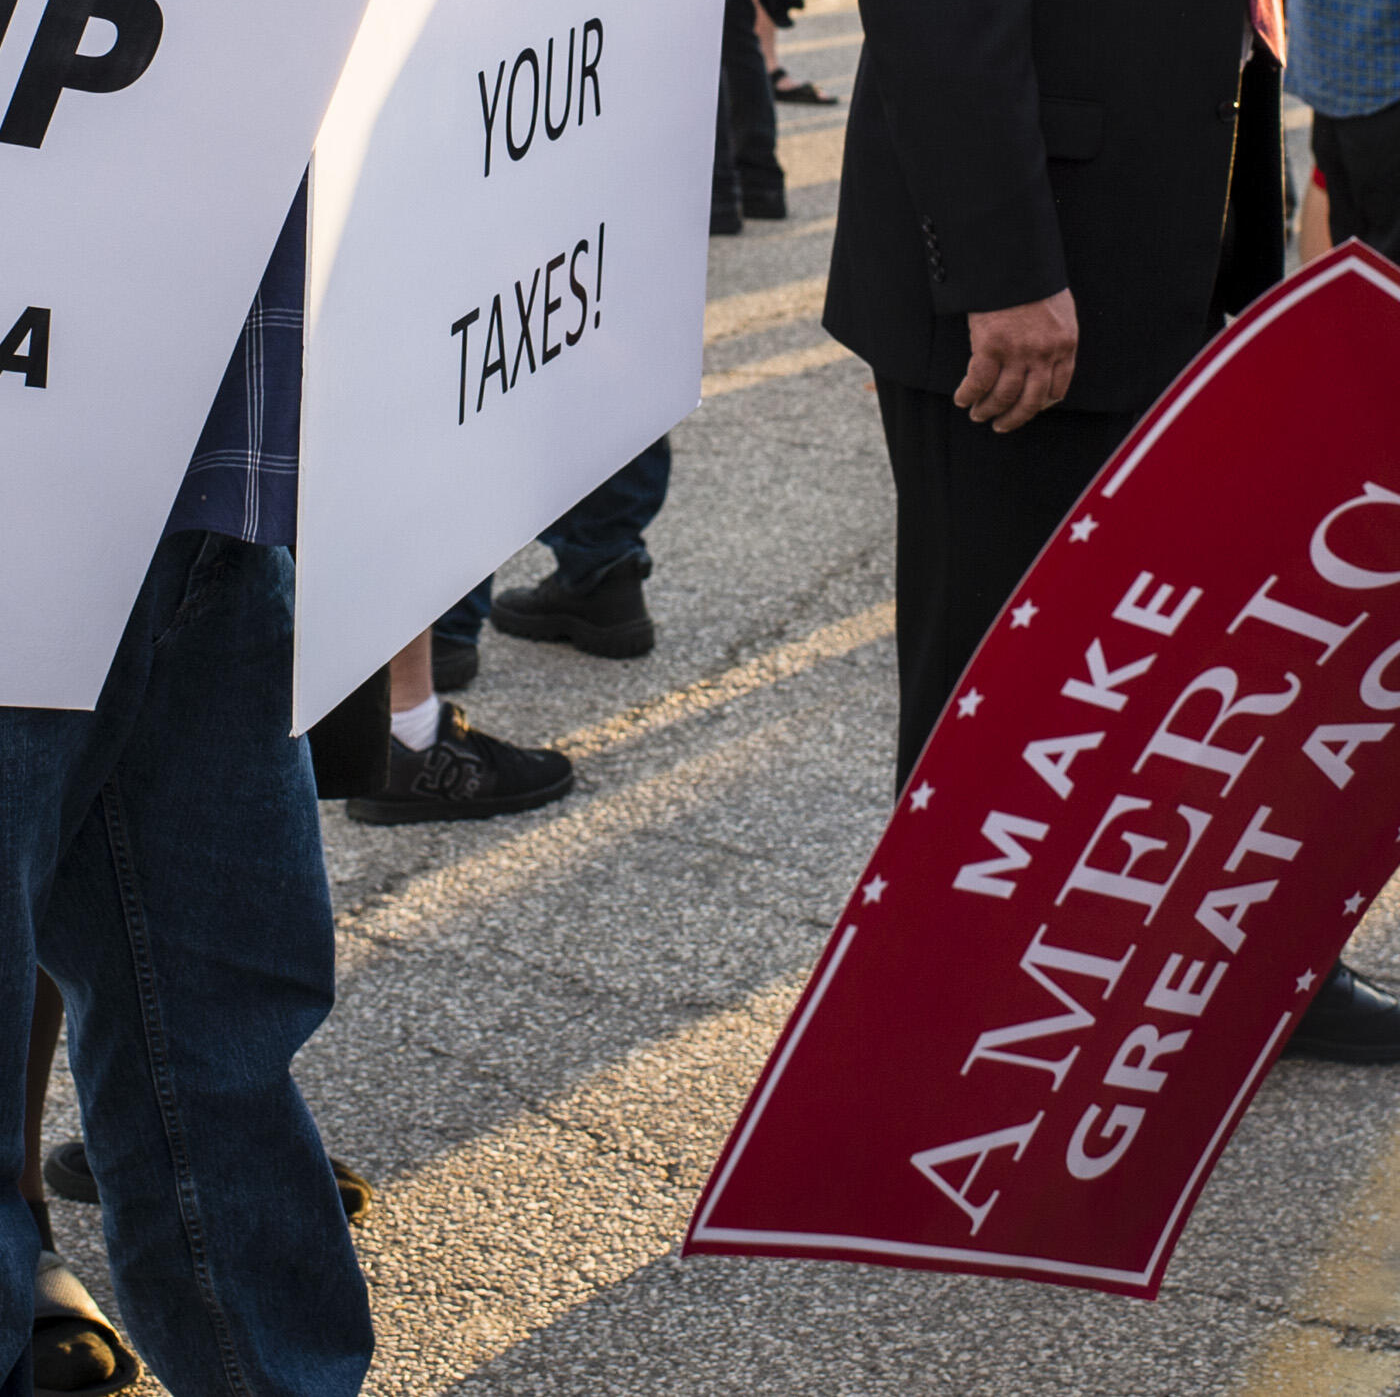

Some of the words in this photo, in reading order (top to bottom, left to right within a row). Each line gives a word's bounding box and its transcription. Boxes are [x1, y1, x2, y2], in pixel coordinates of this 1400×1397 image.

[477, 17, 604, 178] YOUR
[450, 221, 606, 426] TAXES!
[953, 571, 1203, 899] MAKE
[1066, 805, 1303, 1180] GREAT
